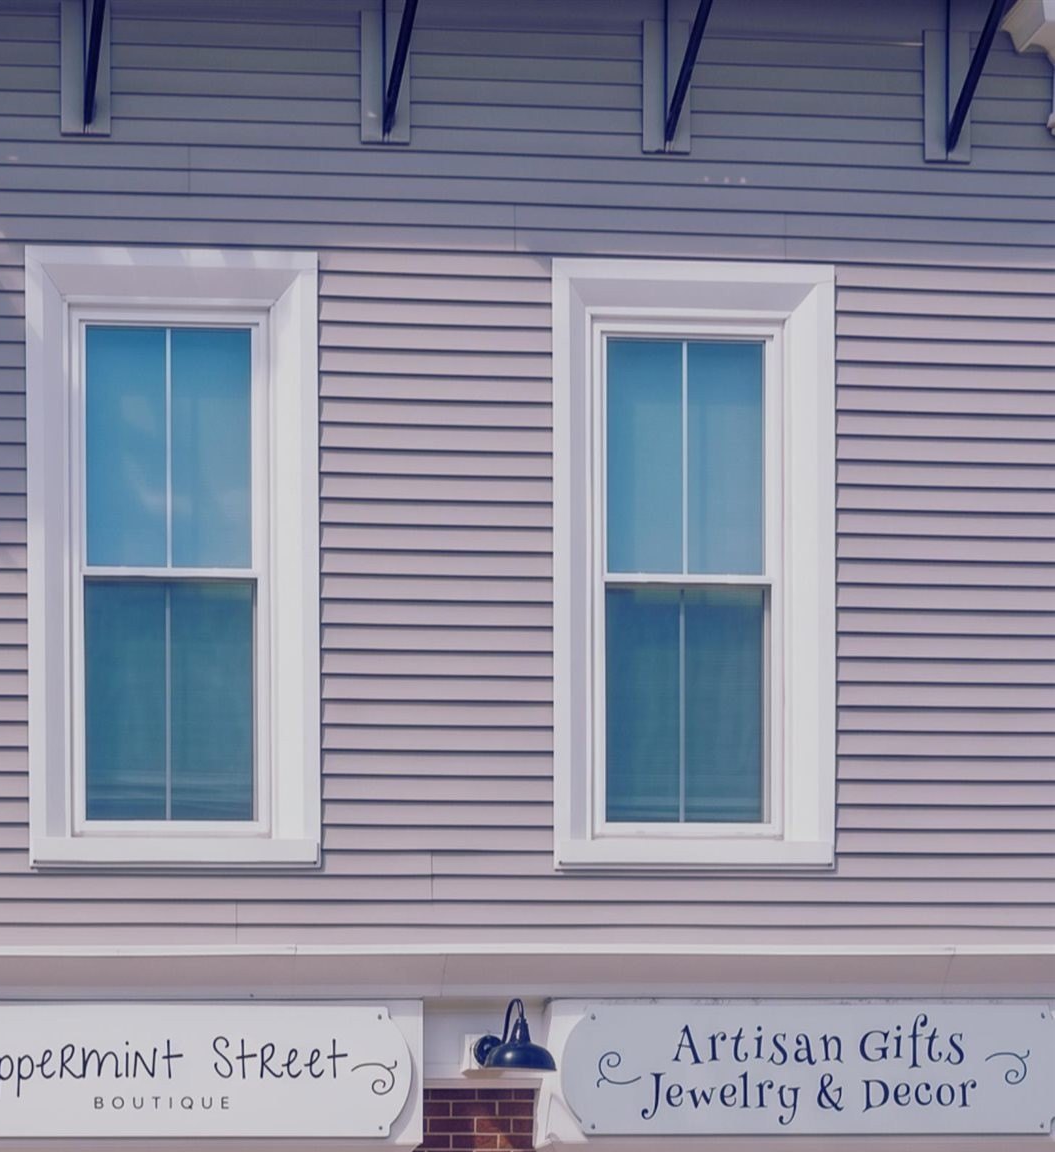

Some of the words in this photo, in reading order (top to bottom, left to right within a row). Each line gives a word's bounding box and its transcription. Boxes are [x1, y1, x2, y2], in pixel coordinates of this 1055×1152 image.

[672, 1025, 843, 1066] Artisan
[859, 1013, 965, 1069] Gifts
[93, 1095, 230, 1110] BOUTIQUE
[641, 1071, 801, 1126] Jewelry
[816, 1073, 845, 1112] &
[862, 1079, 978, 1113] Decor
